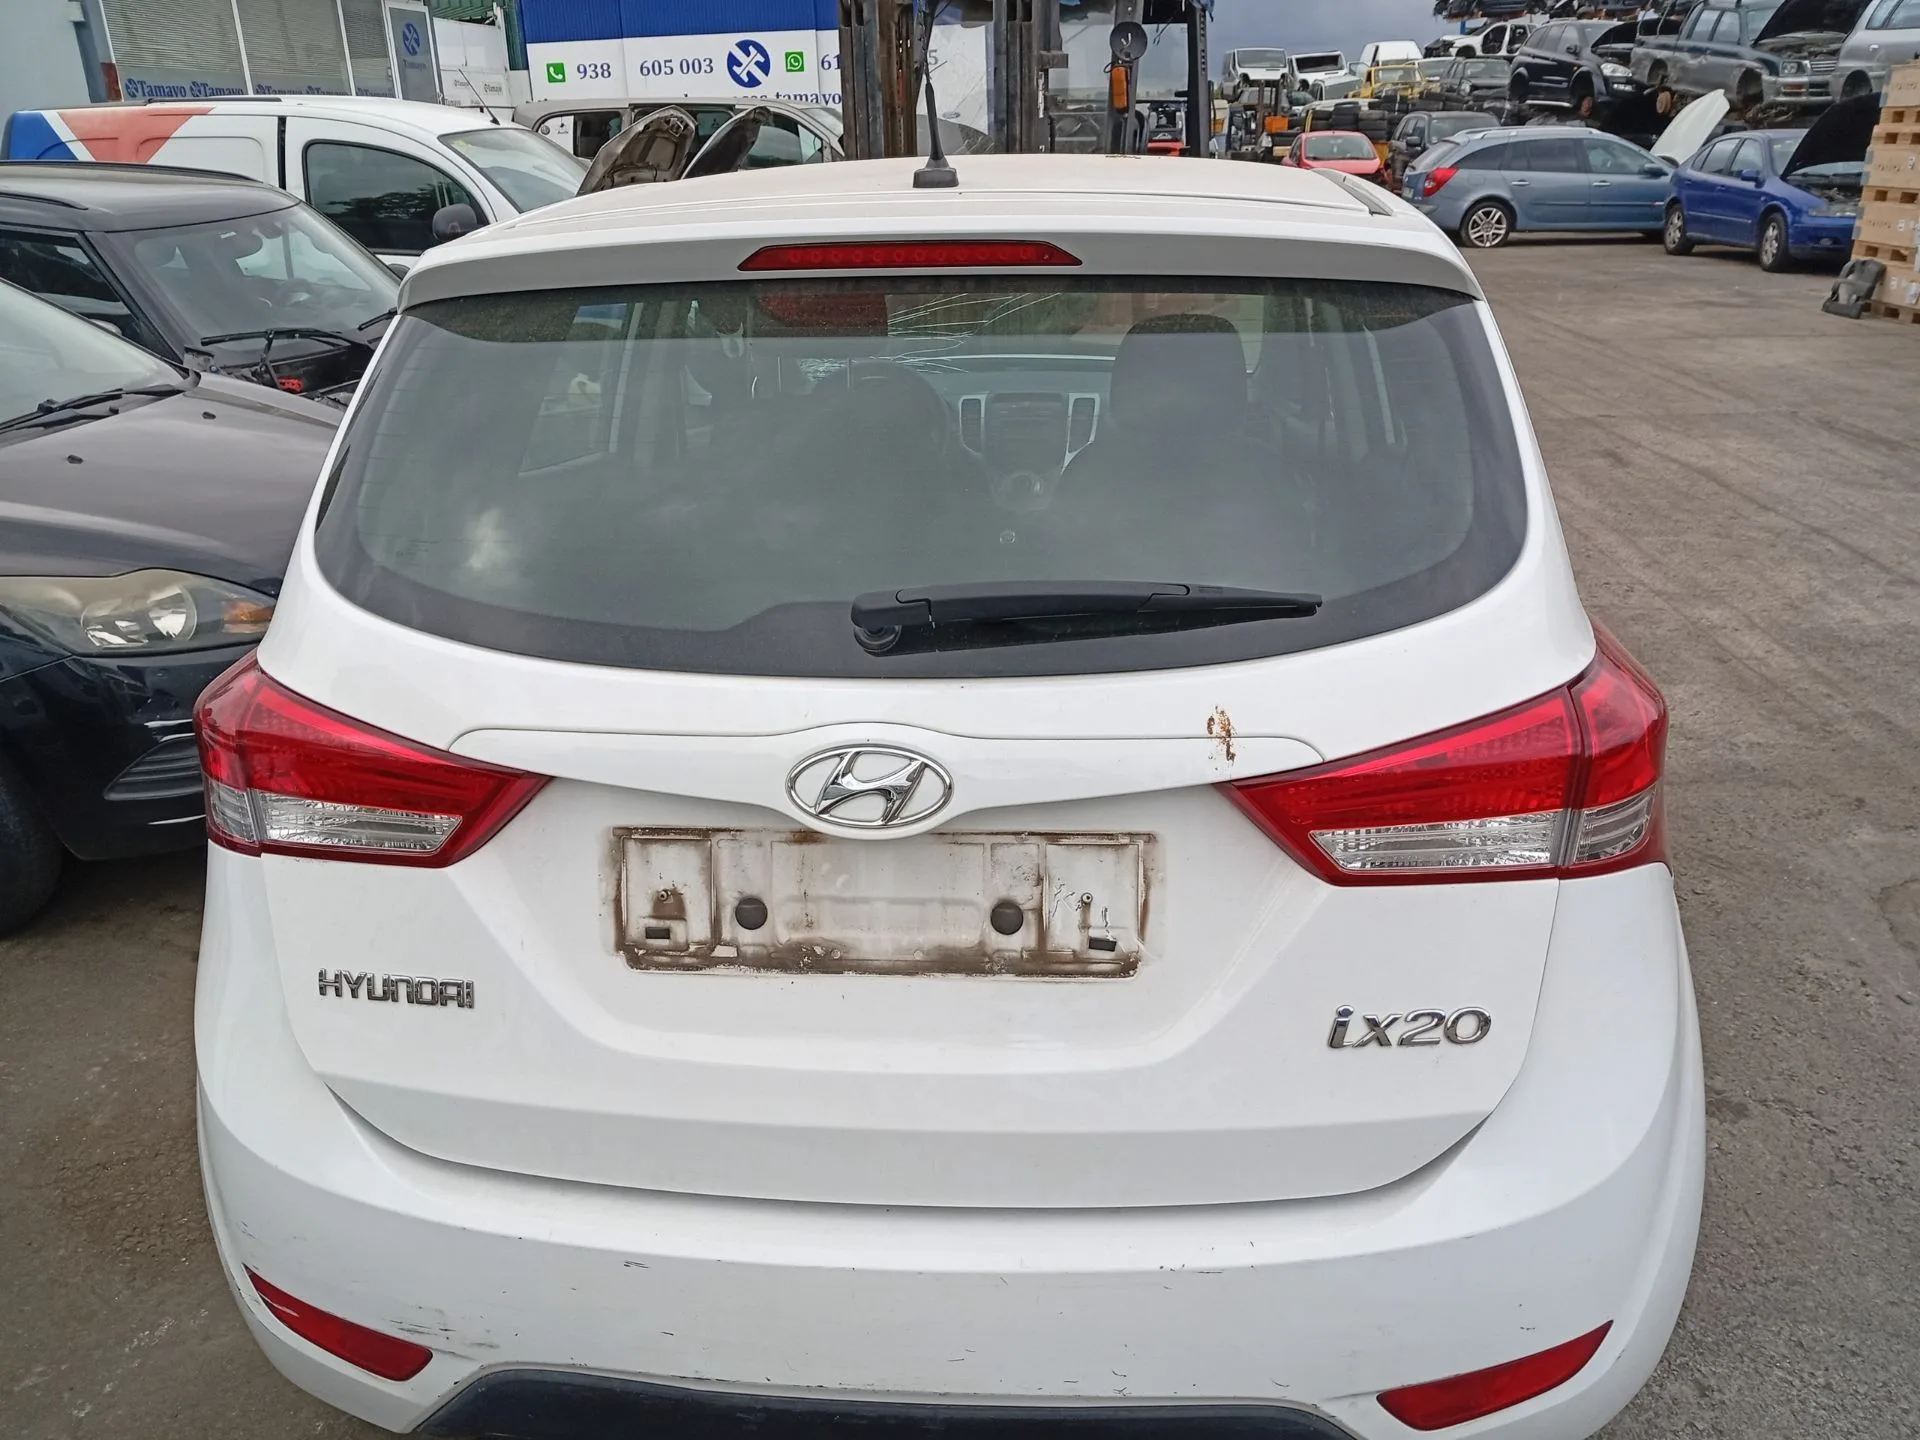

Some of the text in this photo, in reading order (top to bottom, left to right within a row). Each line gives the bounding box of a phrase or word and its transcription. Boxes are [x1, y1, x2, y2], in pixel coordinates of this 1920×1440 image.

[576, 57, 714, 80] 938 605 003
[820, 54, 841, 71] 61
[137, 80, 187, 98] Tamayo
[318, 968, 474, 1009] HYUNDAI
[1327, 1004, 1492, 1049] ix20
